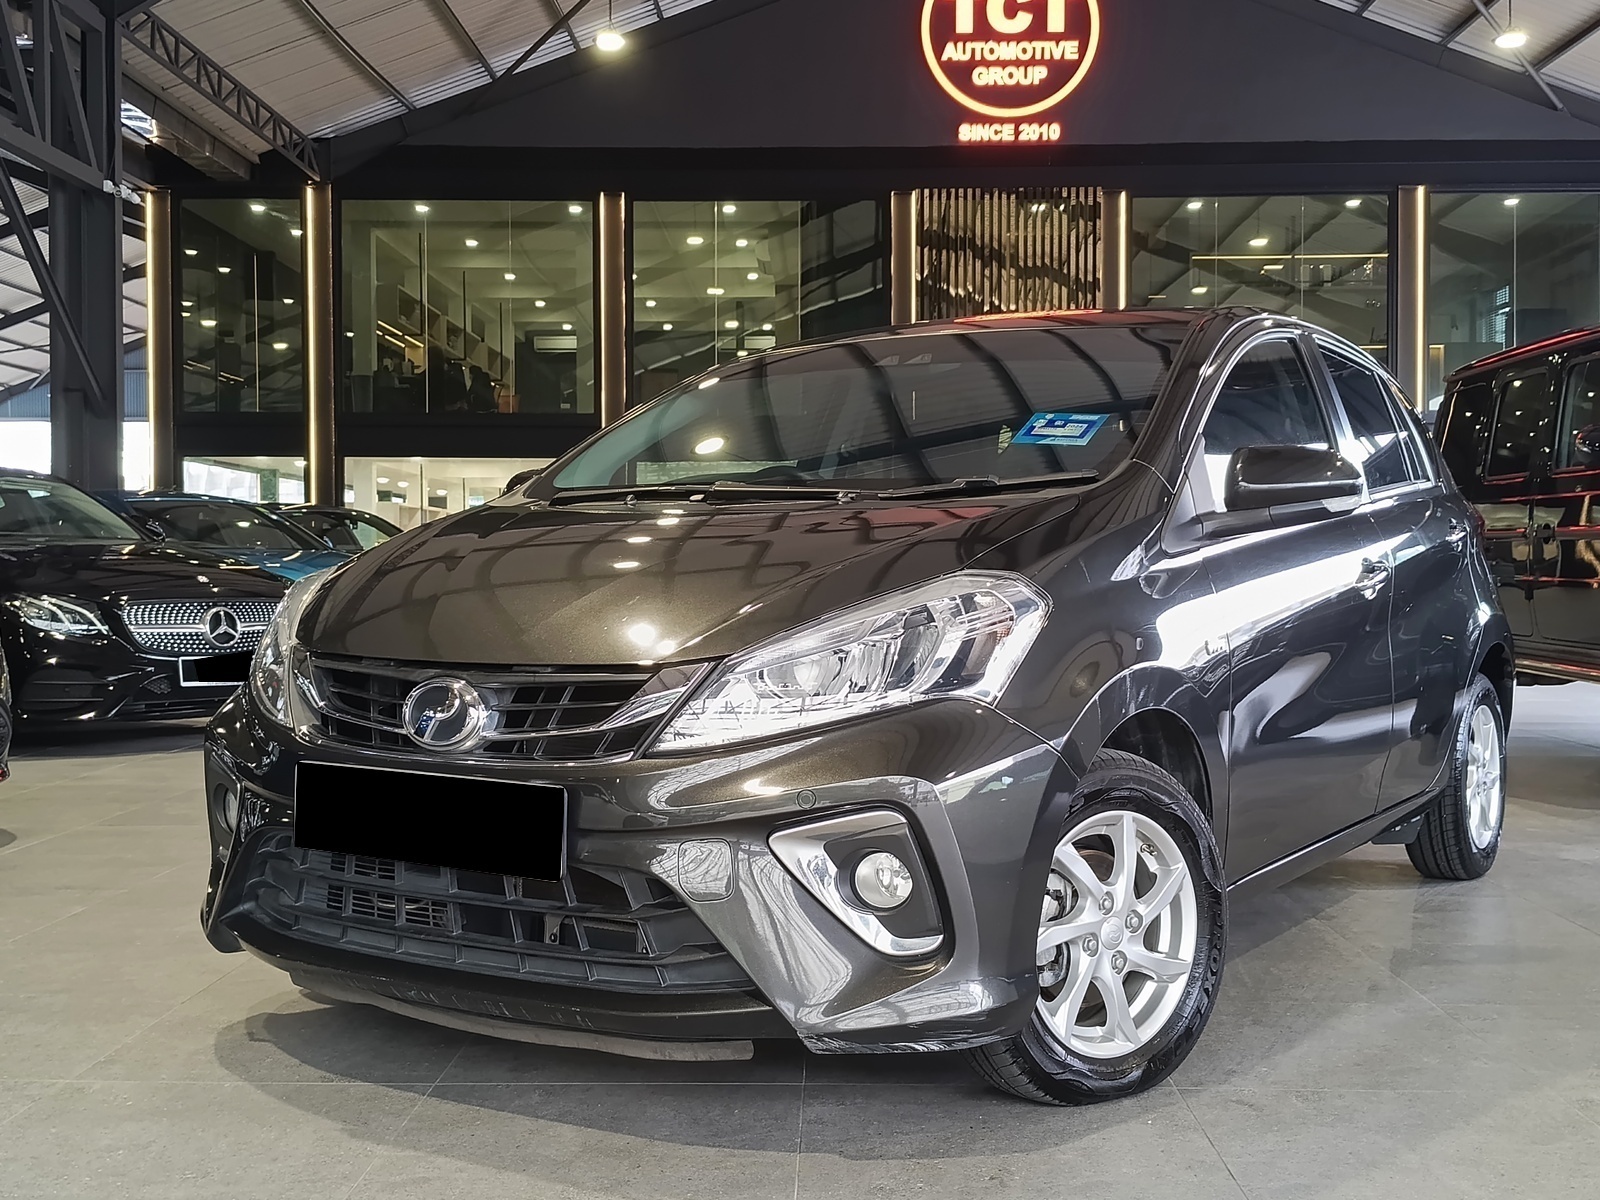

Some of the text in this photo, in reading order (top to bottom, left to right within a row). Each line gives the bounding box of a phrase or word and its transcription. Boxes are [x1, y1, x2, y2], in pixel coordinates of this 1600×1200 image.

[941, 41, 1079, 61] AUTOMOTIVE
[972, 66, 1048, 86] GROUP
[958, 124, 1061, 141] SINCE 2010
